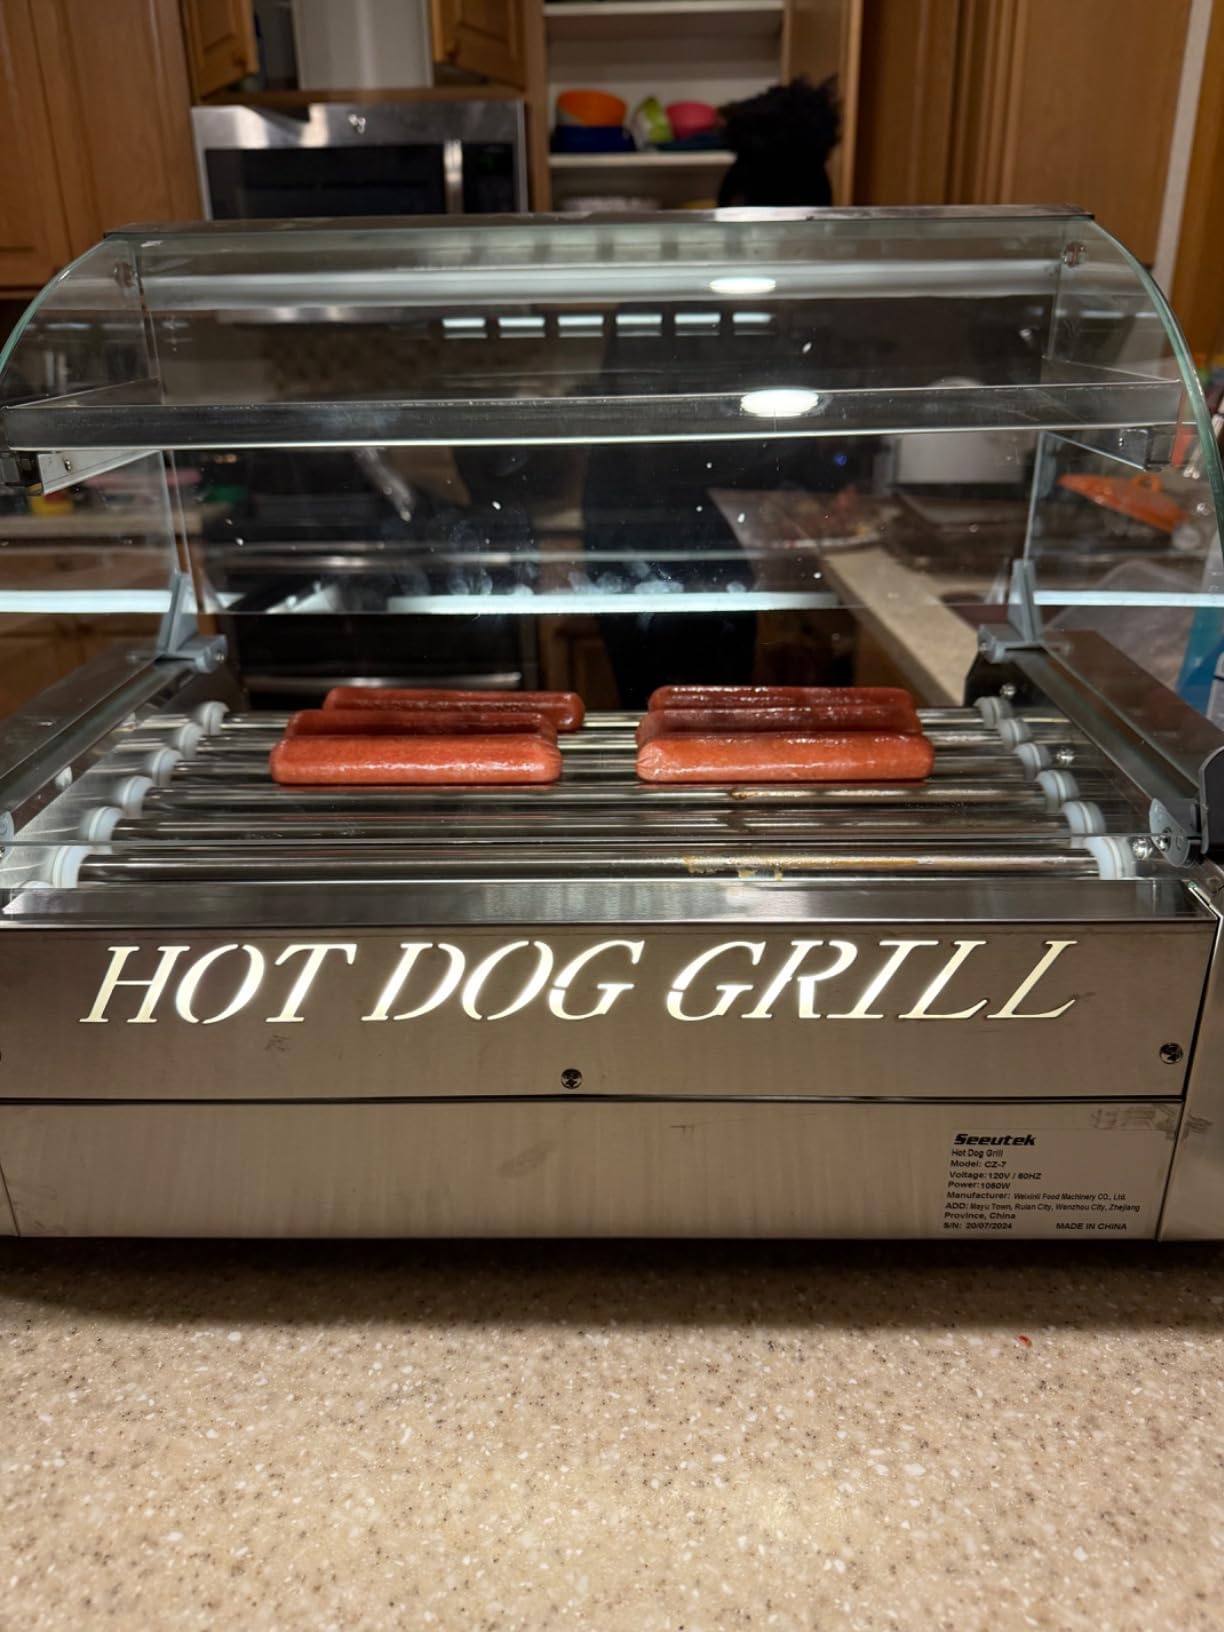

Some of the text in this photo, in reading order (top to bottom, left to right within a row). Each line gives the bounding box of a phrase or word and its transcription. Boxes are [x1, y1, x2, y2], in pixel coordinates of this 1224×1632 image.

[79, 940, 1078, 1024] HOT DOG GRILL
[954, 1133, 1036, 1146] Seeutek
[952, 1149, 1003, 1158] Hot Dog Grill
[951, 1160, 982, 1168] Model:
[946, 1191, 1010, 1199] Manufacturer:
[1061, 1193, 1096, 1202] Machinery
[1037, 1203, 1054, 1212] City,
[1109, 1204, 1140, 1212] Zhejiang
[944, 1212, 986, 1220] Province,
